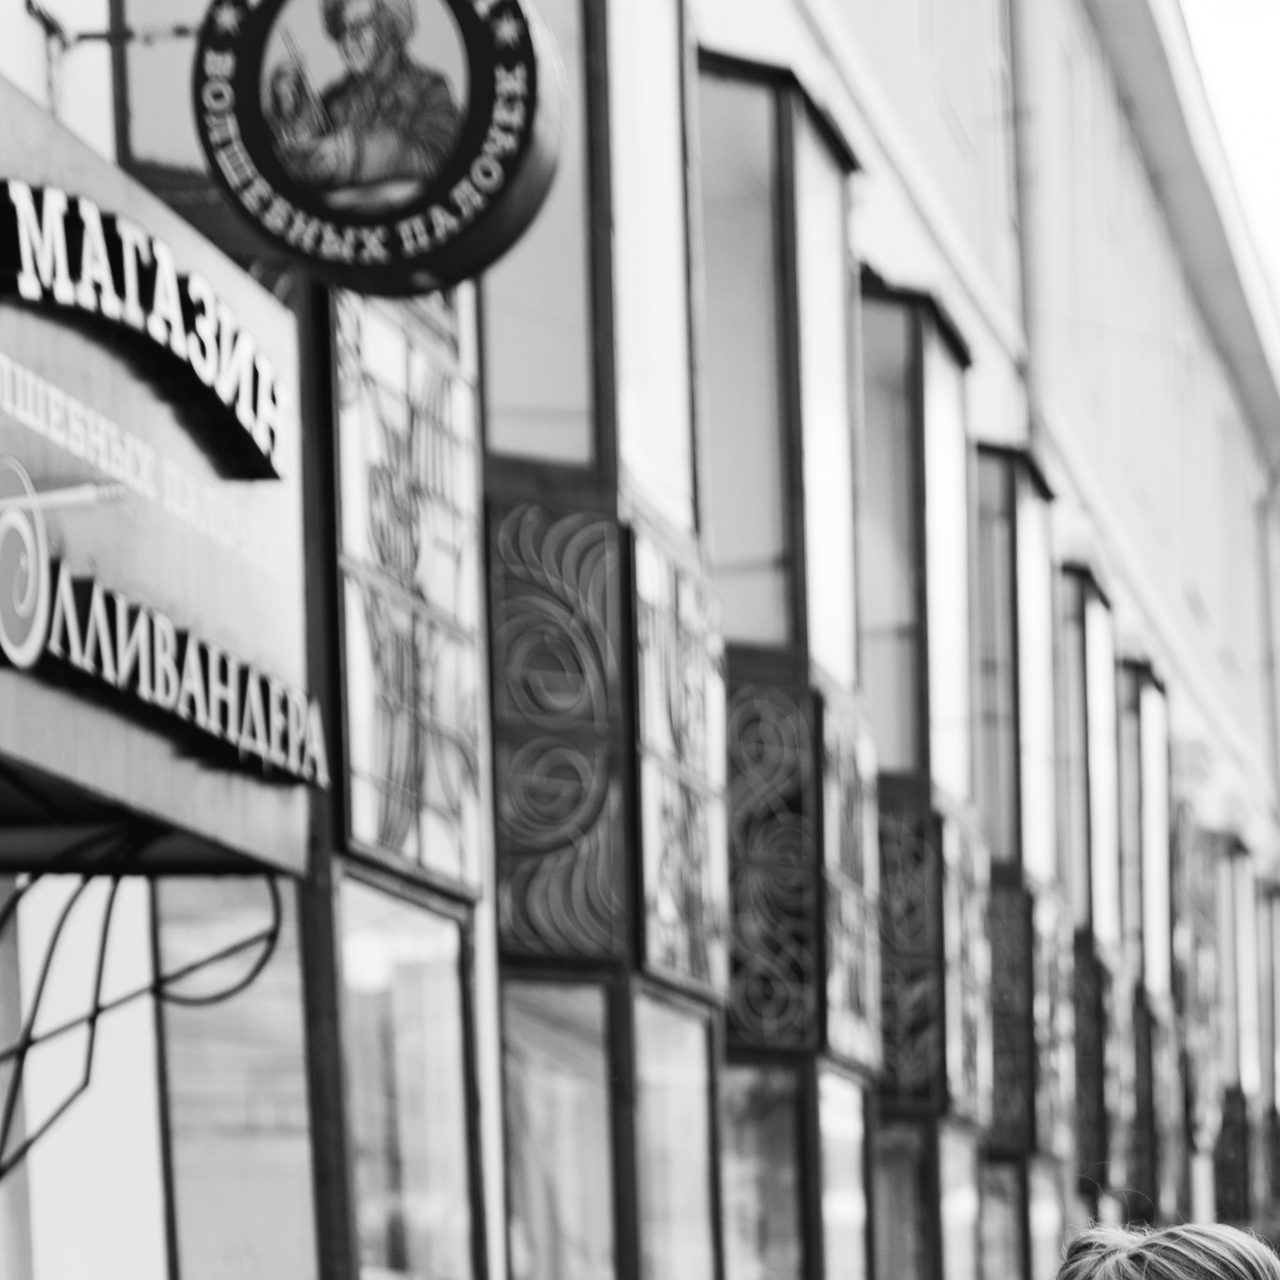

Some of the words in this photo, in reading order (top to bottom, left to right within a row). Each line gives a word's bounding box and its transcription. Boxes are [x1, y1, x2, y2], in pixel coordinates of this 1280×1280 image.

[202, 49, 388, 264] ВОЛШЕБНЫХ
[396, 60, 527, 257] ПАЛОЧЕК
[8, 180, 294, 476] МАГАЗИН
